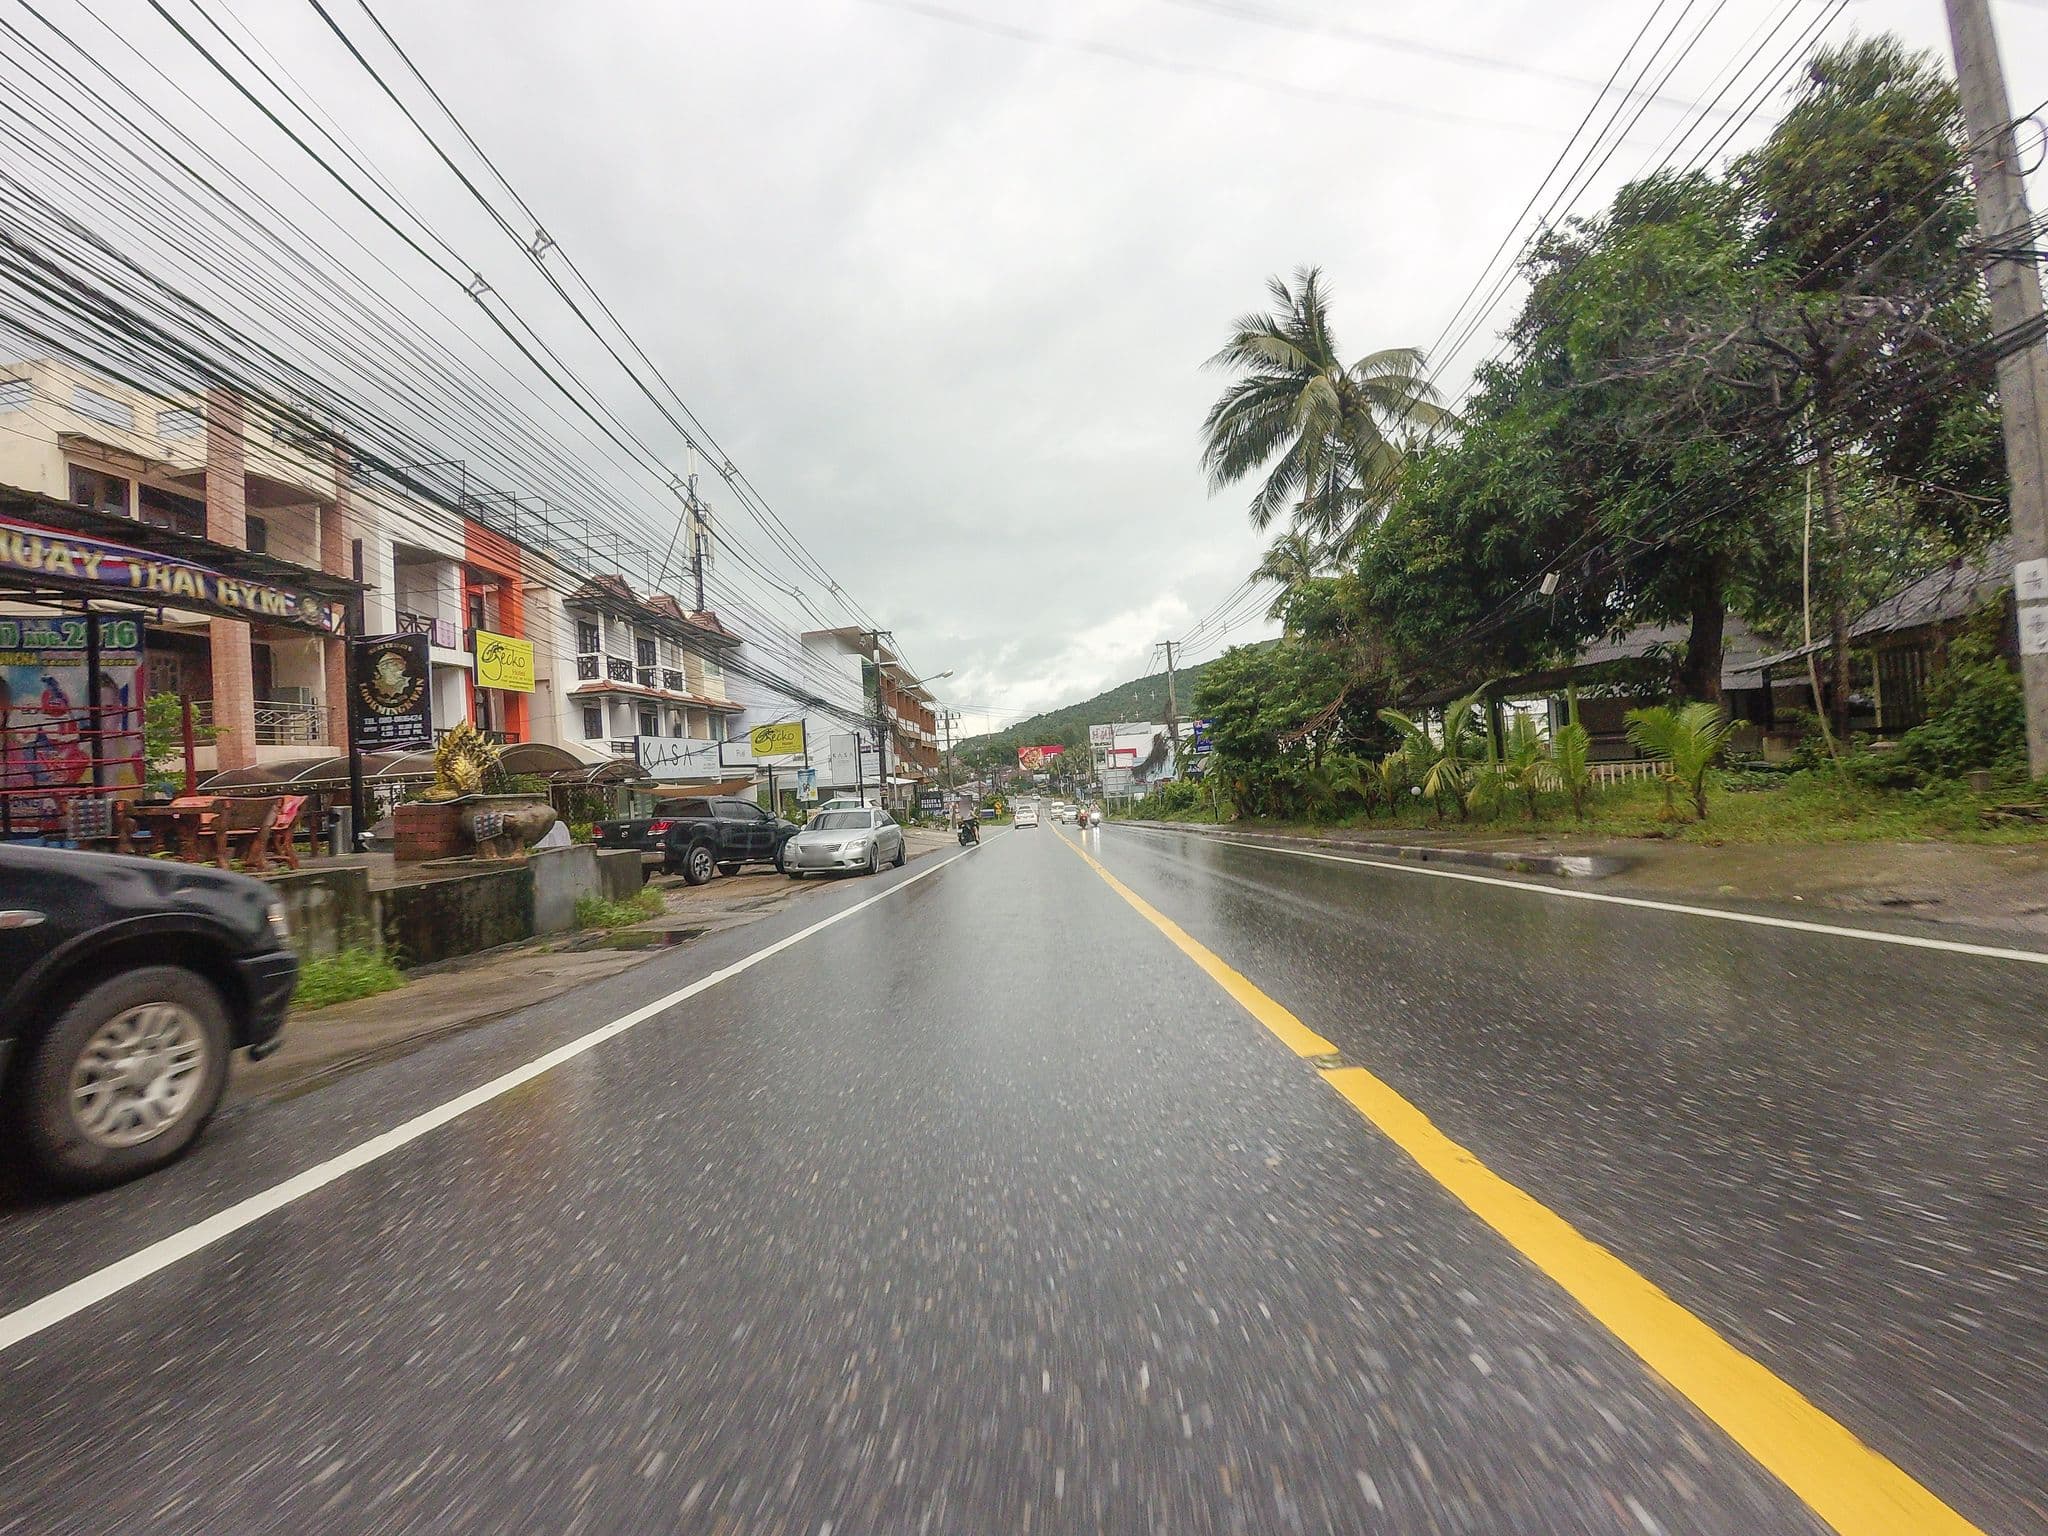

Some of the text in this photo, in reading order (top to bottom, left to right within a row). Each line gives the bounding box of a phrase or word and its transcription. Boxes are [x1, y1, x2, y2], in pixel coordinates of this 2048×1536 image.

[123, 556, 206, 599] THAI
[216, 577, 288, 616] GYM
[481, 641, 525, 681] Gecko
[642, 742, 692, 767] KASA
[755, 728, 795, 753] Gecko
